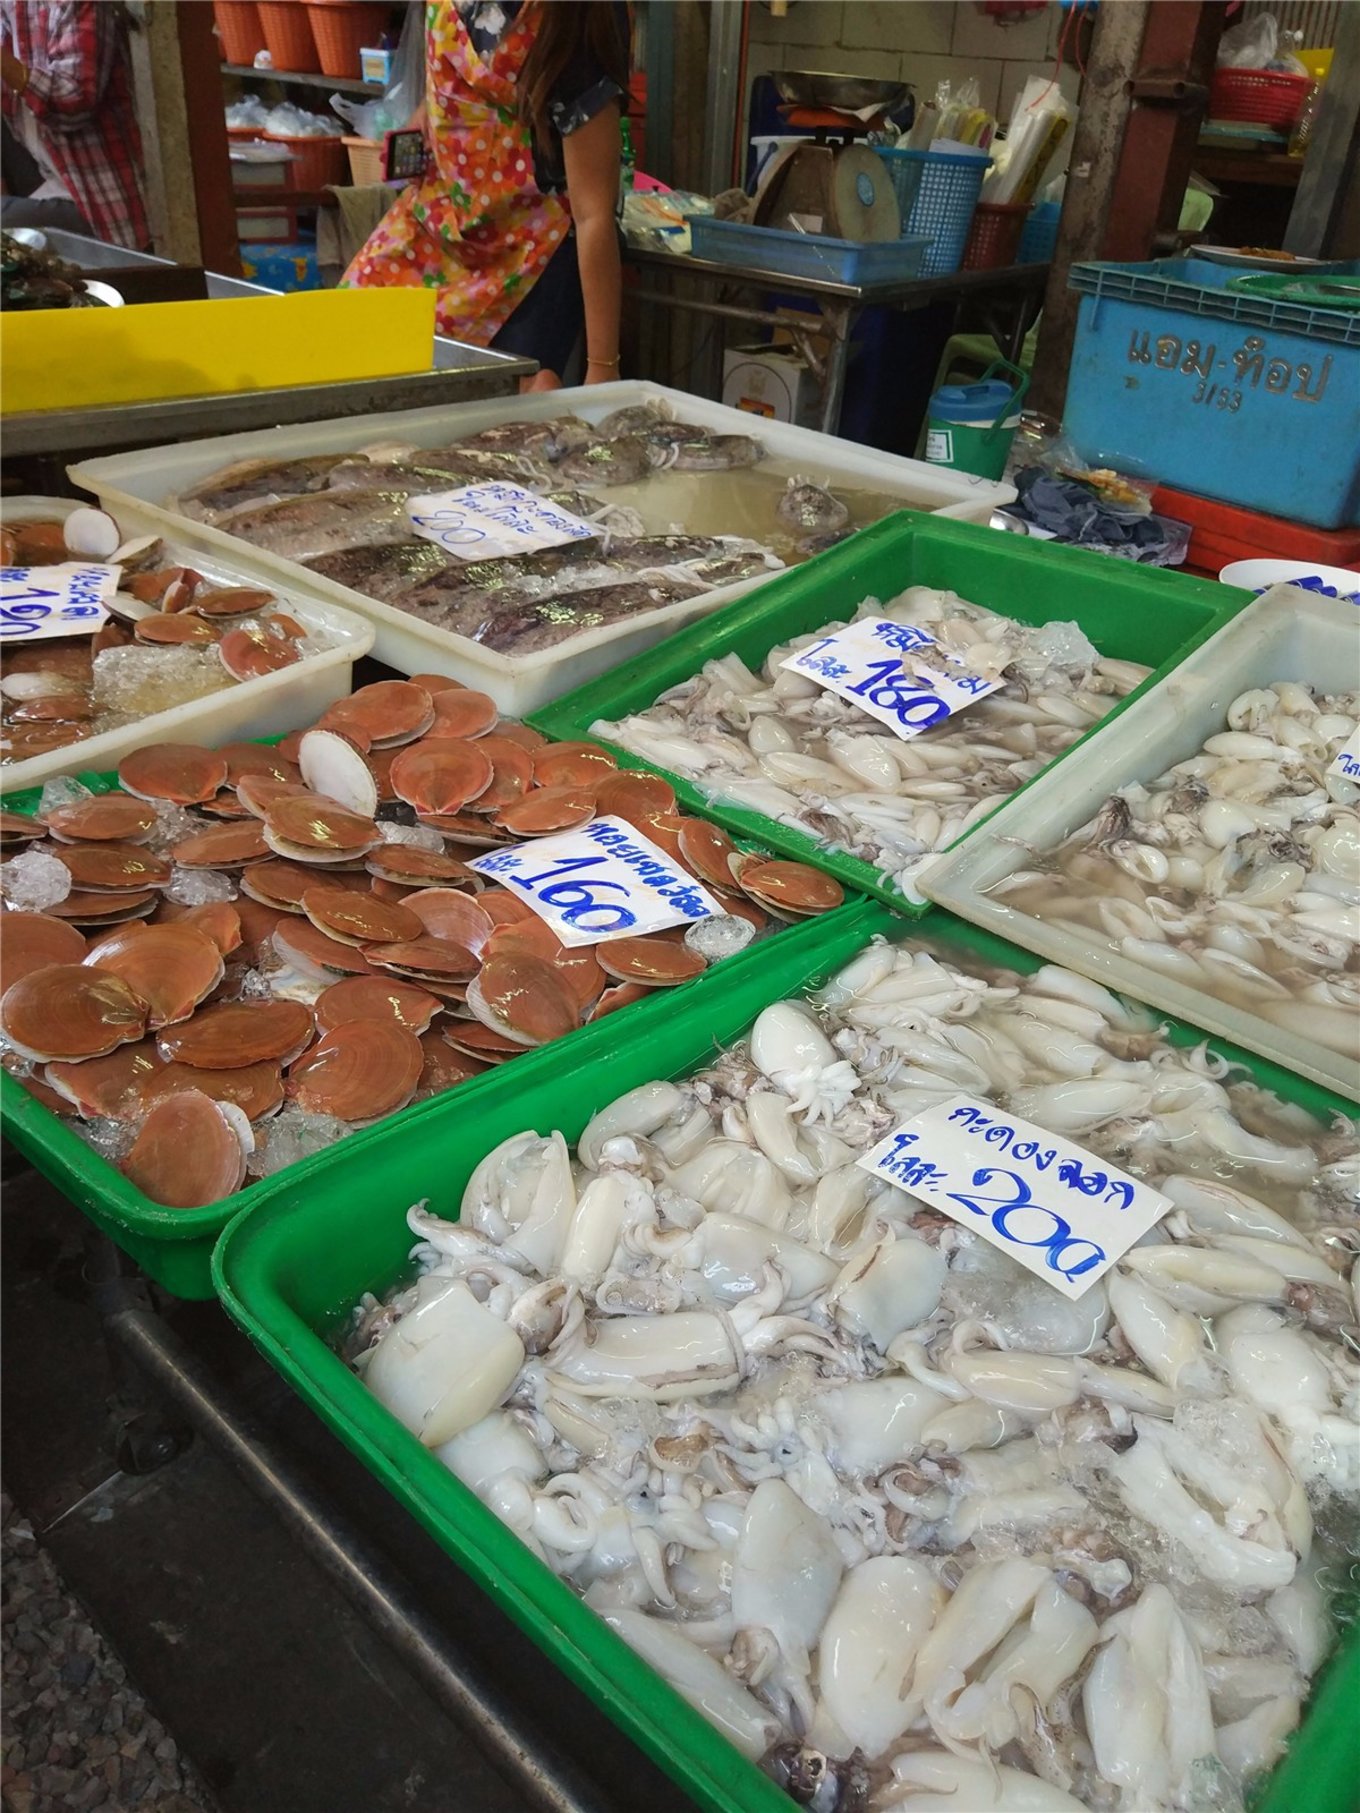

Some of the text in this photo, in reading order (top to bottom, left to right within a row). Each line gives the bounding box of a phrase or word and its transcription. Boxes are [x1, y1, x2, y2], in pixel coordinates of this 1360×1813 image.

[845, 659, 951, 730] 180
[509, 856, 638, 933] 160
[946, 1167, 1106, 1283] 200
